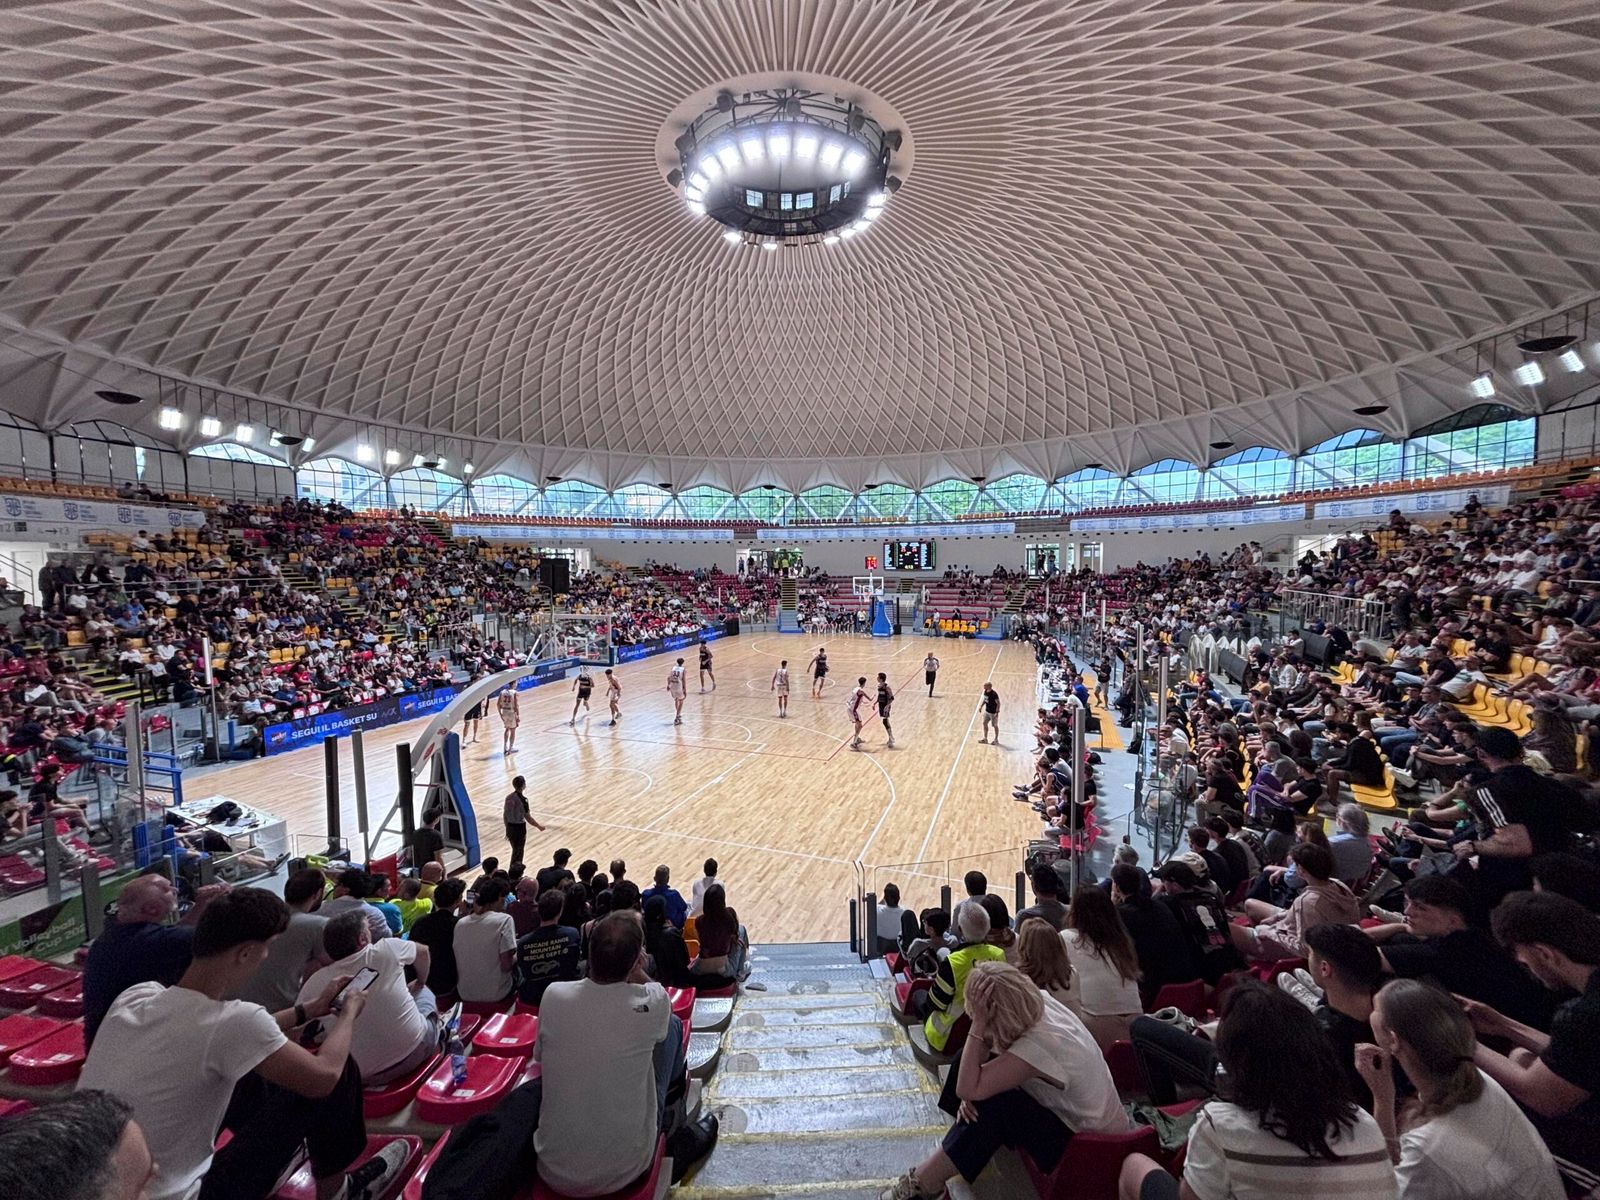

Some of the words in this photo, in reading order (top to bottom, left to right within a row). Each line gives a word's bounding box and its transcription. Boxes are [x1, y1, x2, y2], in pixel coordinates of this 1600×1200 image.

[291, 726, 321, 740] SEGUI
[321, 724, 331, 733] IL
[331, 715, 366, 729] BASKET
[365, 712, 378, 721] SU
[12, 917, 76, 950] Volleyball
[36, 936, 62, 952] Cup
[530, 944, 562, 954] MOUNTAIN
[523, 953, 545, 961] RESCUE
